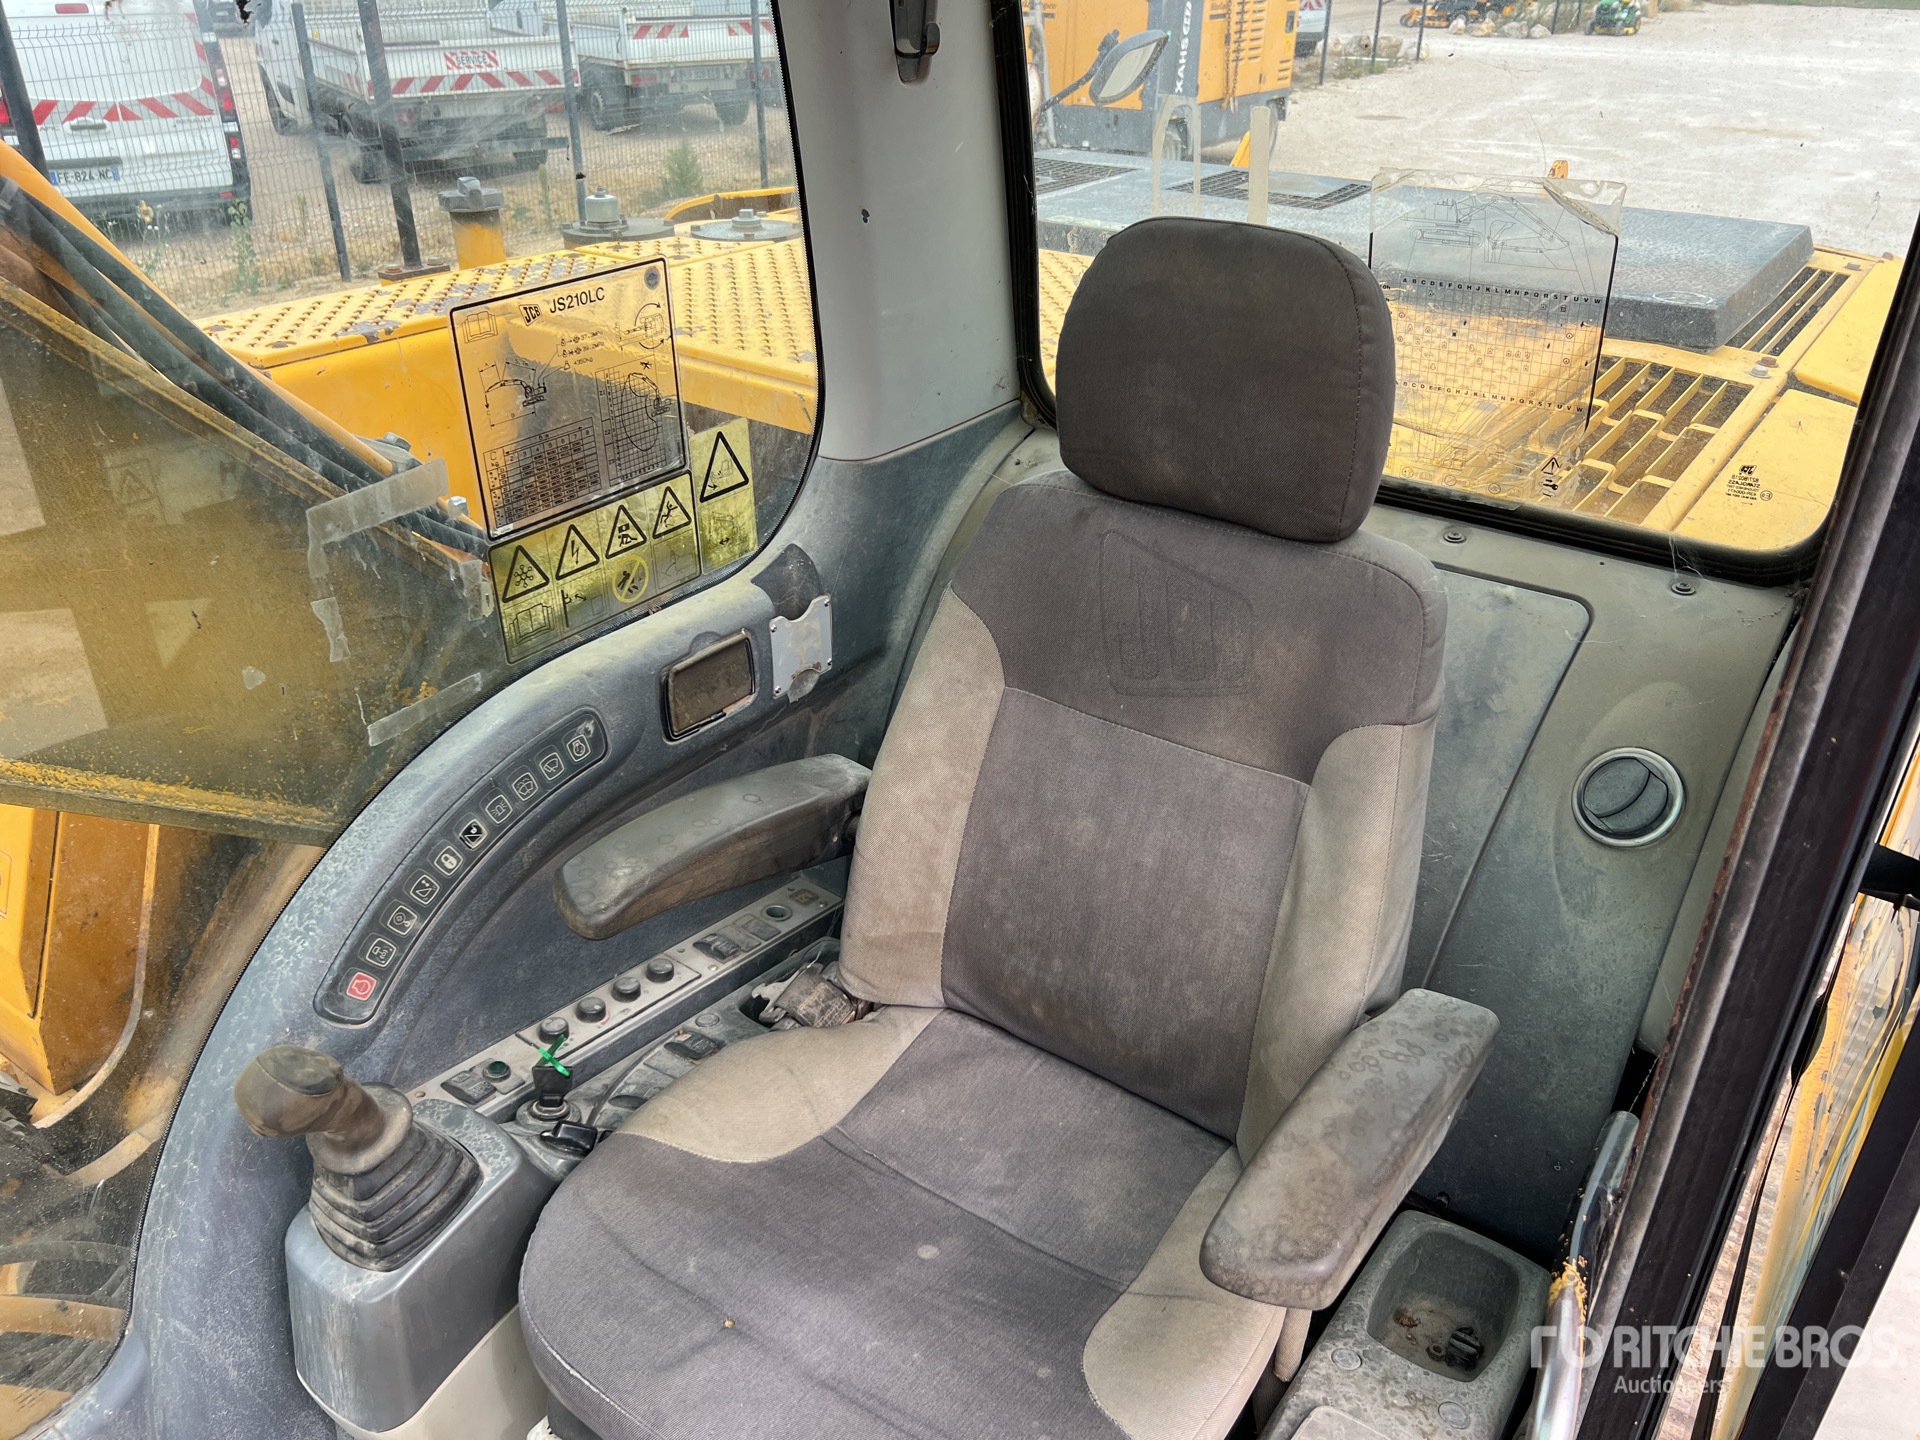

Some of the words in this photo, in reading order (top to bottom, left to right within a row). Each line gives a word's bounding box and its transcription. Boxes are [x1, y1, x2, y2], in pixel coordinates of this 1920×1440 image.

[456, 54, 488, 65] SERVICE
[1174, 38, 1189, 94] XAHS
[550, 286, 606, 314] JS210LC
[524, 306, 541, 324] JCB
[490, 452, 497, 461] C
